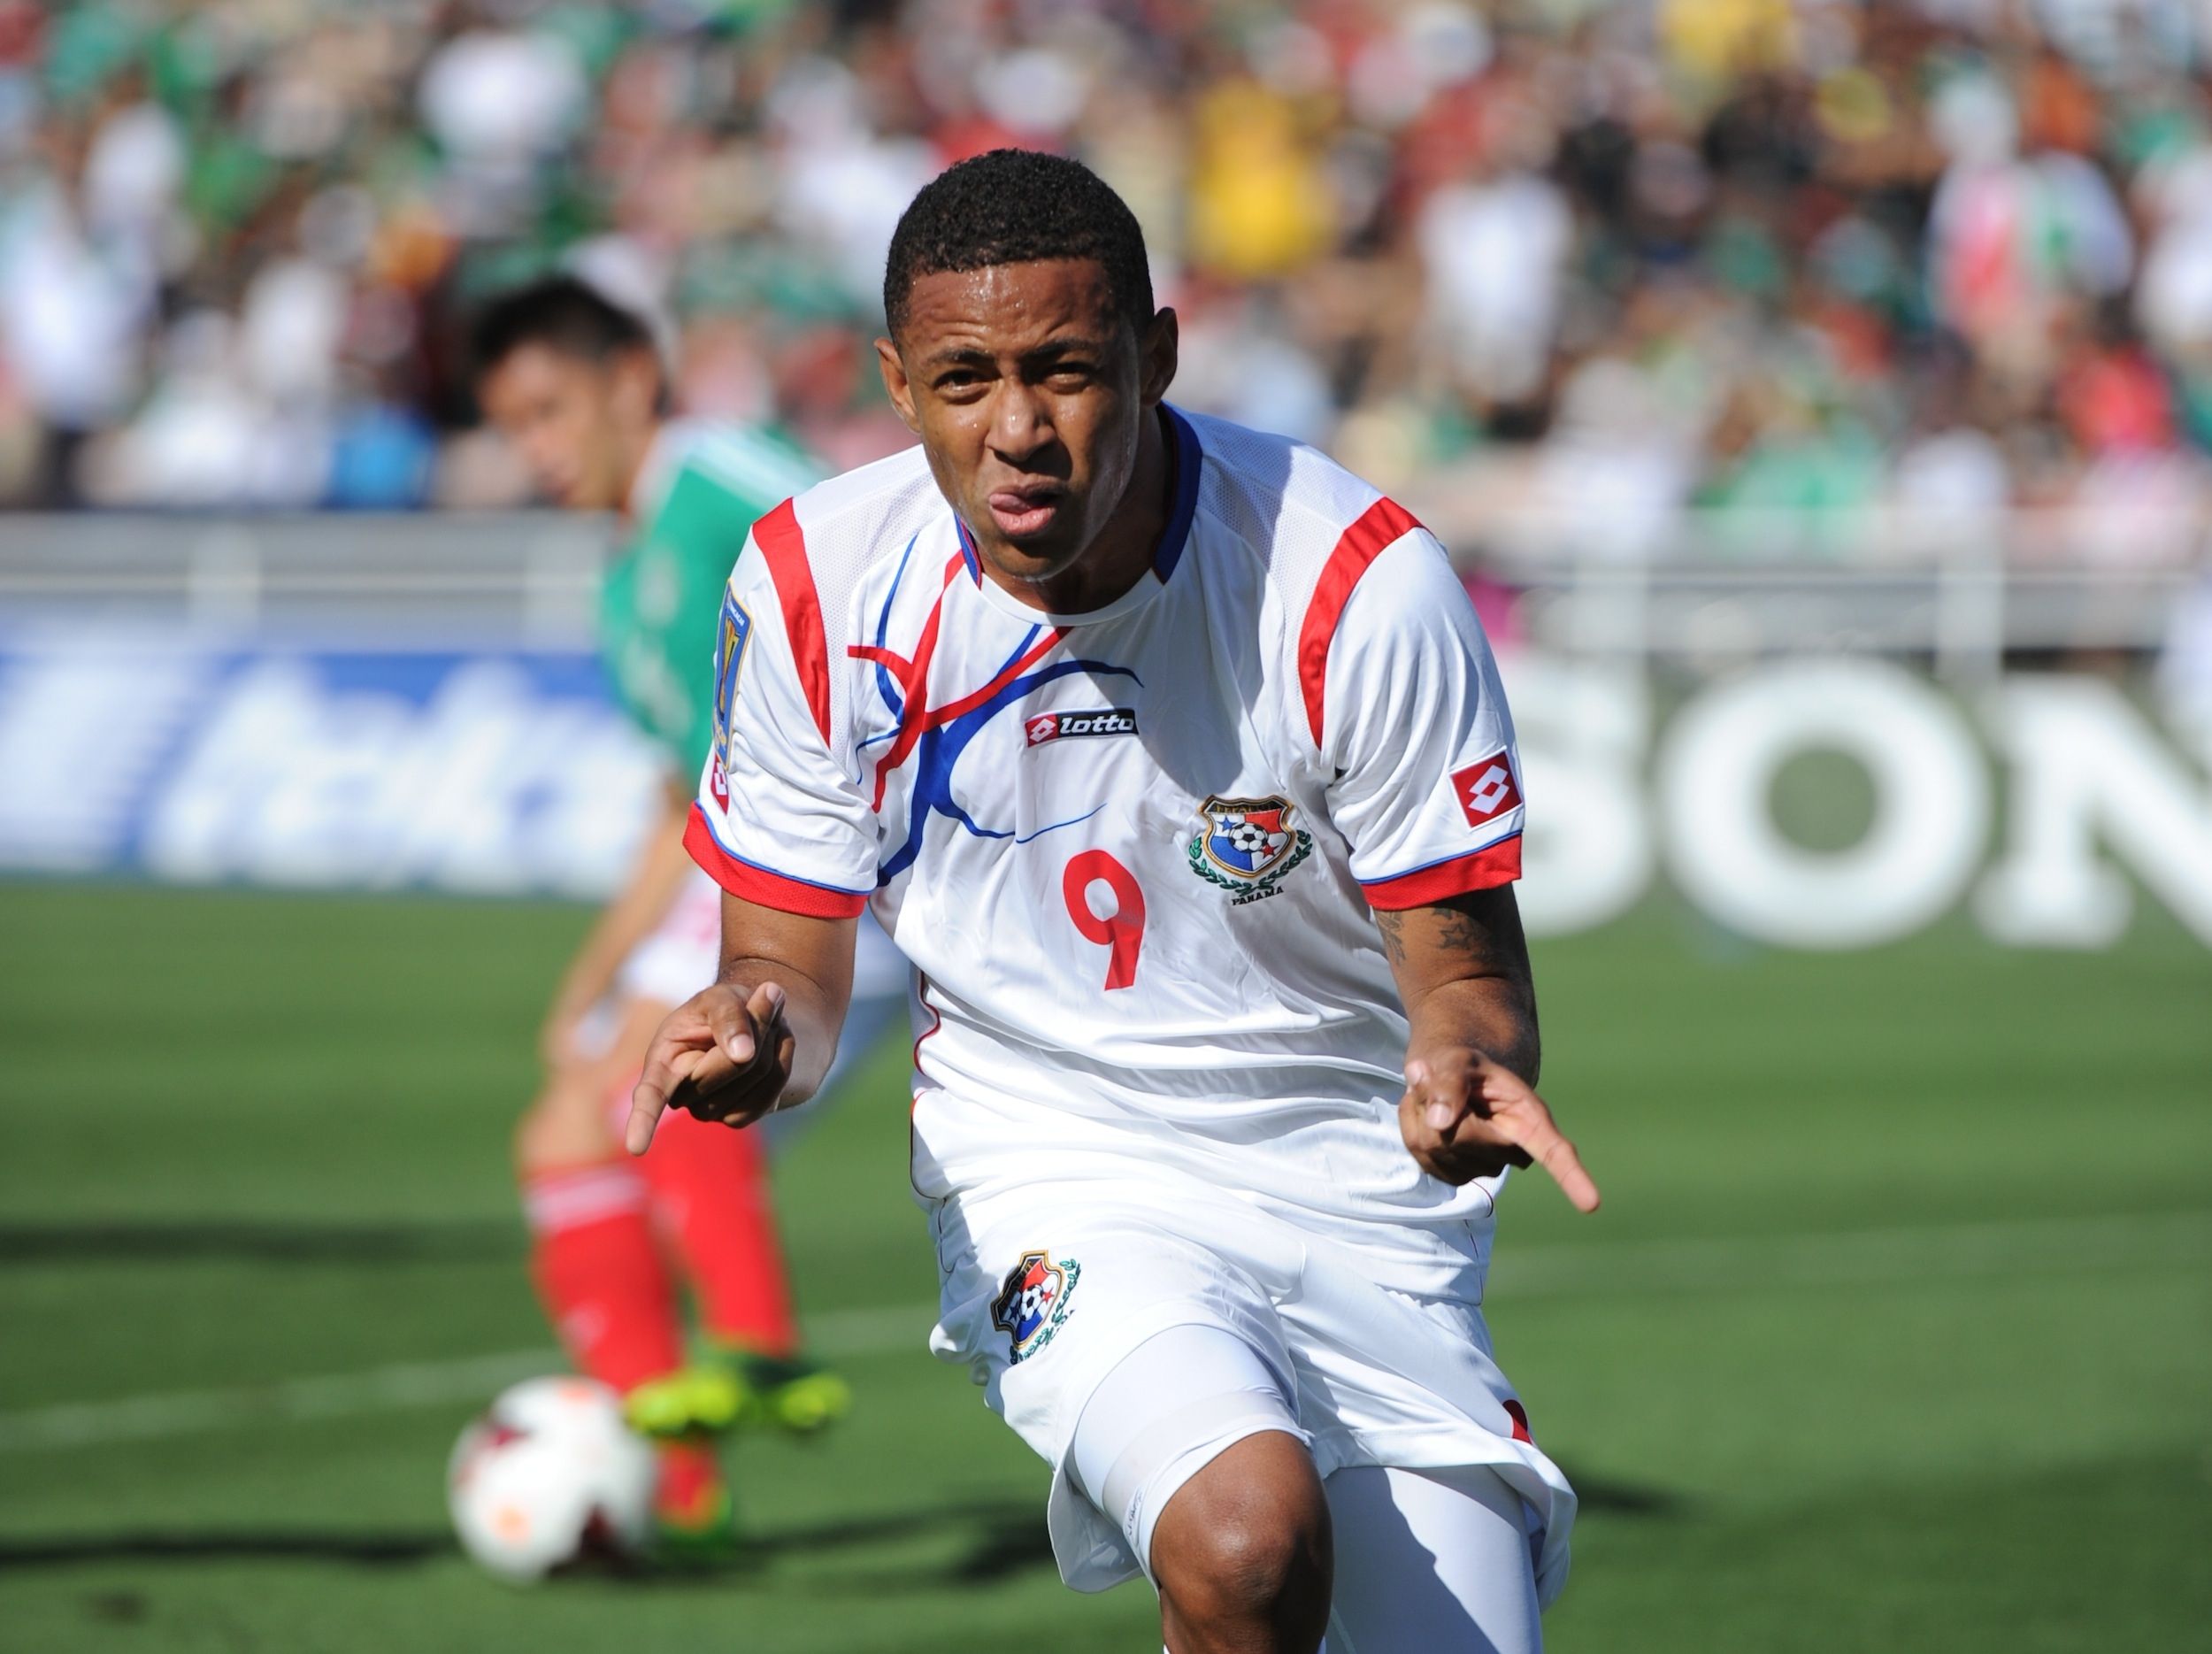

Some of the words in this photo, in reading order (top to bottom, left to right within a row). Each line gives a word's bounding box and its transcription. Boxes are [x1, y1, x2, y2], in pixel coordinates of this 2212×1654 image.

[1060, 715, 1133, 734] lotto
[1231, 886, 1284, 906] PANAMA
[1063, 850, 1146, 991] 9
